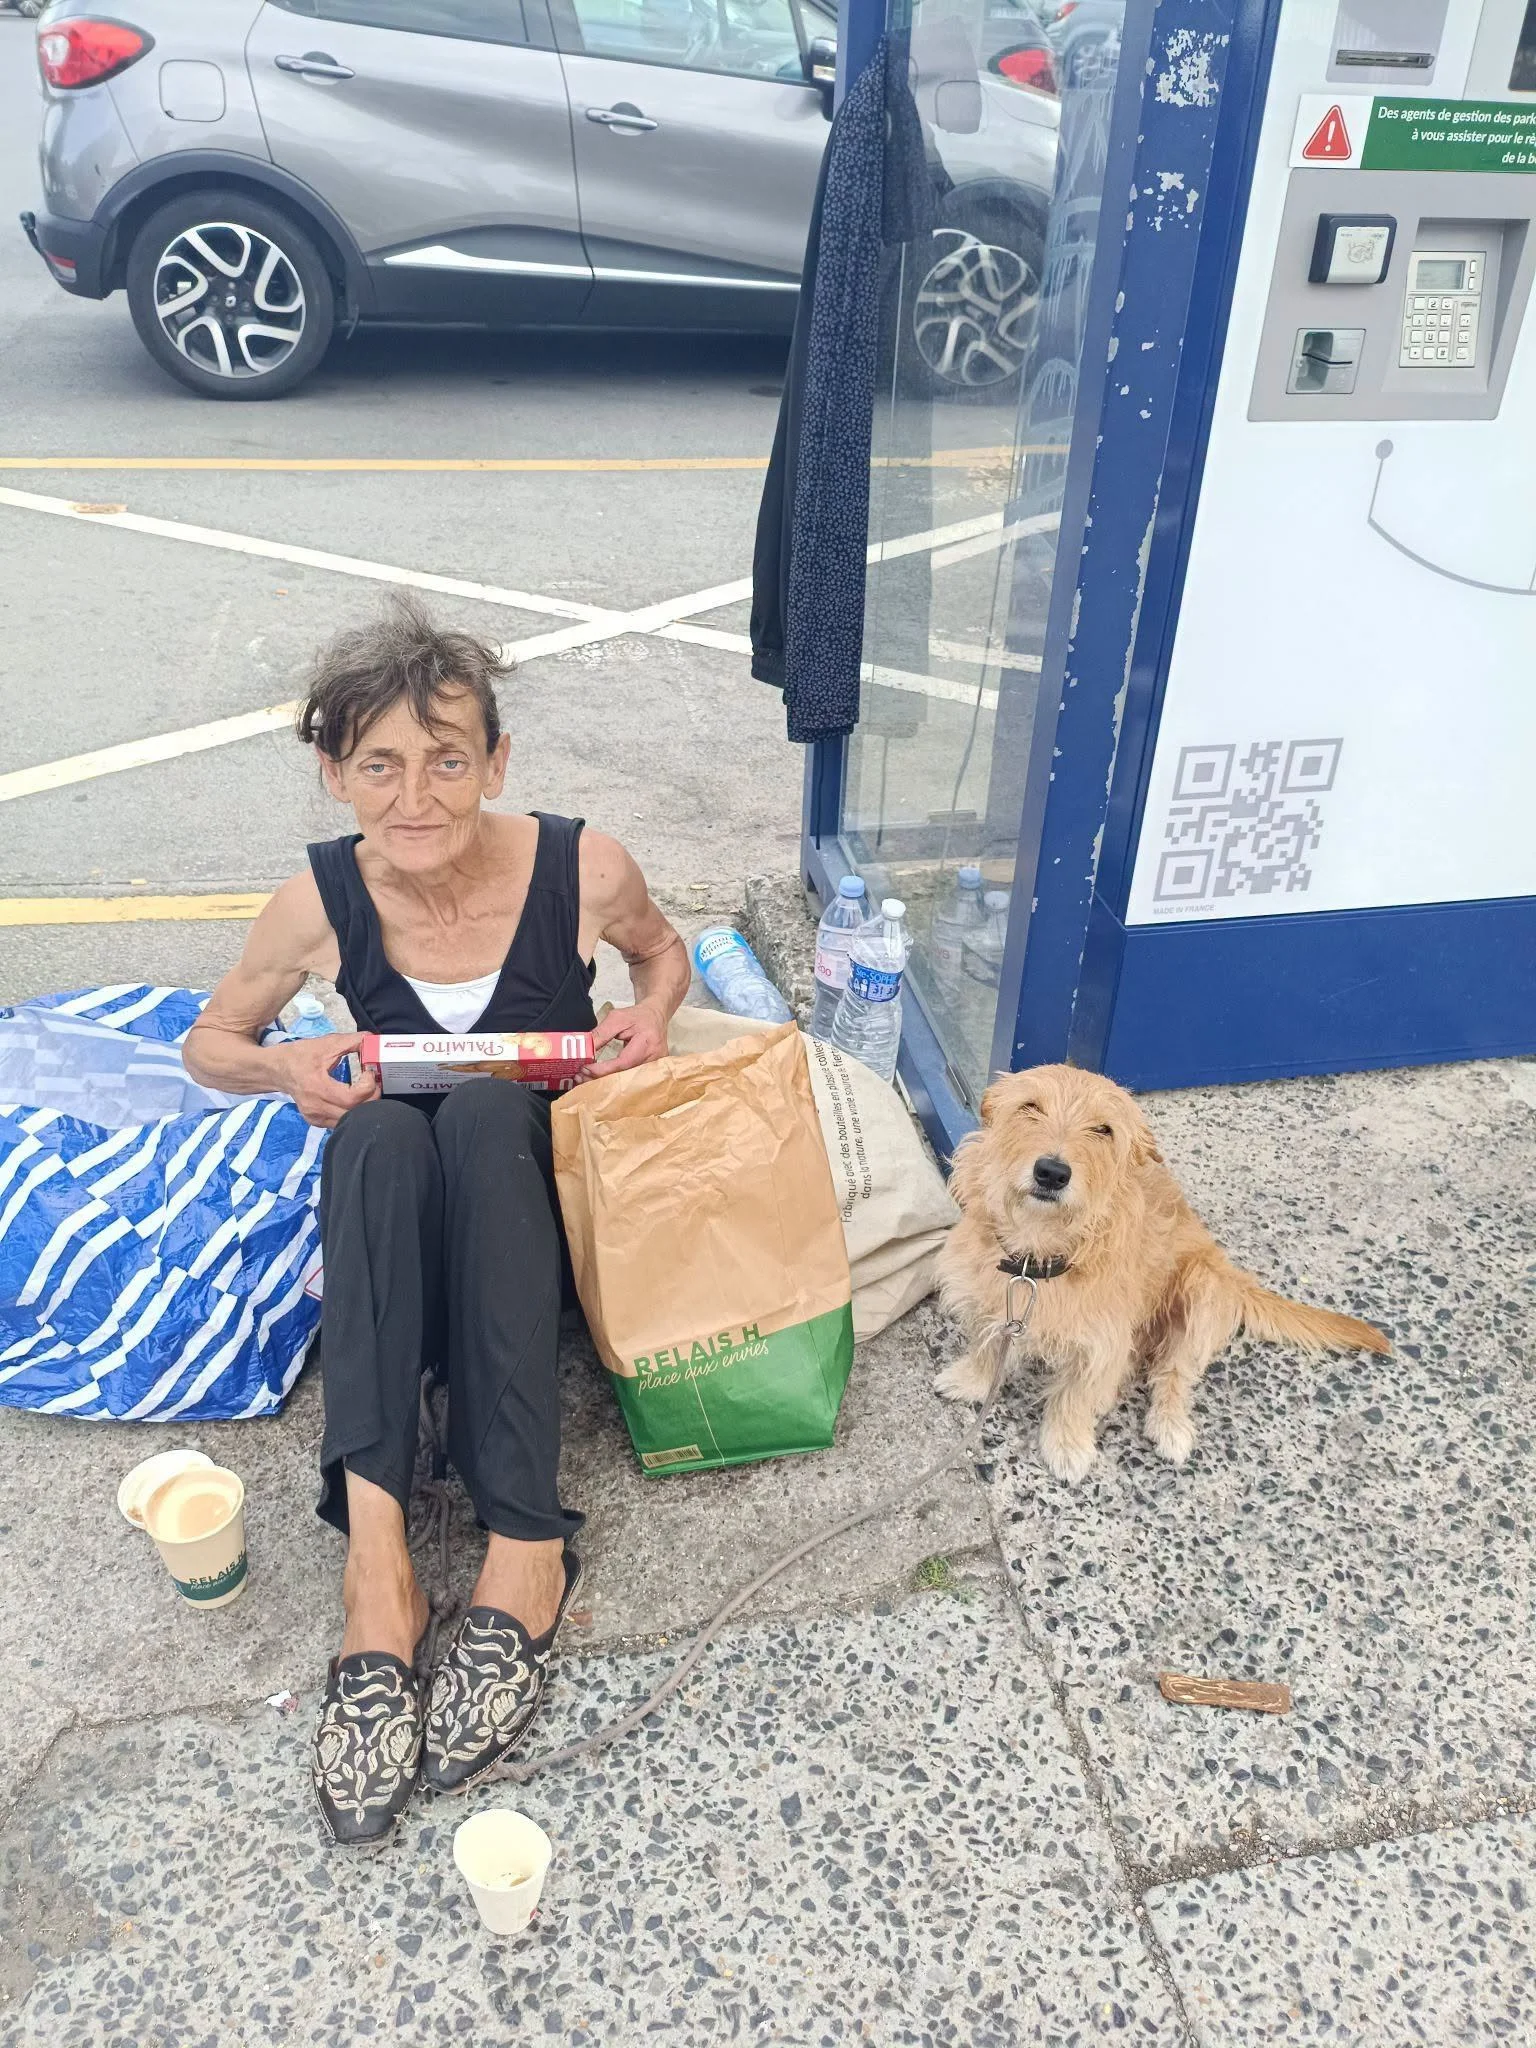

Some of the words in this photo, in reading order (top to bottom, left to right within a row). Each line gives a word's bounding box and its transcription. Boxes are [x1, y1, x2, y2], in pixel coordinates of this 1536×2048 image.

[1378, 106, 1399, 119] Des
[1400, 108, 1436, 122] agents
[1438, 108, 1452, 121] de
[1452, 110, 1492, 124] gestion
[1493, 111, 1512, 123] des
[1411, 128, 1419, 140] à
[1420, 131, 1446, 141] vous
[1446, 130, 1487, 143] assister
[1487, 133, 1513, 145] pour
[1513, 132, 1524, 144] le
[1501, 152, 1516, 164] de
[1516, 152, 1527, 164] la
[1153, 906, 1174, 915] MADE
[1175, 905, 1184, 913] IN
[1184, 904, 1215, 913] FRANCE
[841, 1074, 853, 1096] source
[831, 1093, 840, 1101] en
[833, 1102, 848, 1141] bouteilles
[852, 1117, 862, 1134] une
[840, 1143, 851, 1159] des
[860, 1174, 872, 1199] dans
[841, 1178, 858, 1223] Fabriqué
[634, 1331, 733, 1377] RELAIS
[742, 1323, 761, 1344] H
[638, 1371, 682, 1396] place
[684, 1360, 719, 1381] aux
[722, 1339, 769, 1368] envies
[189, 1561, 236, 1586] RELAIS
